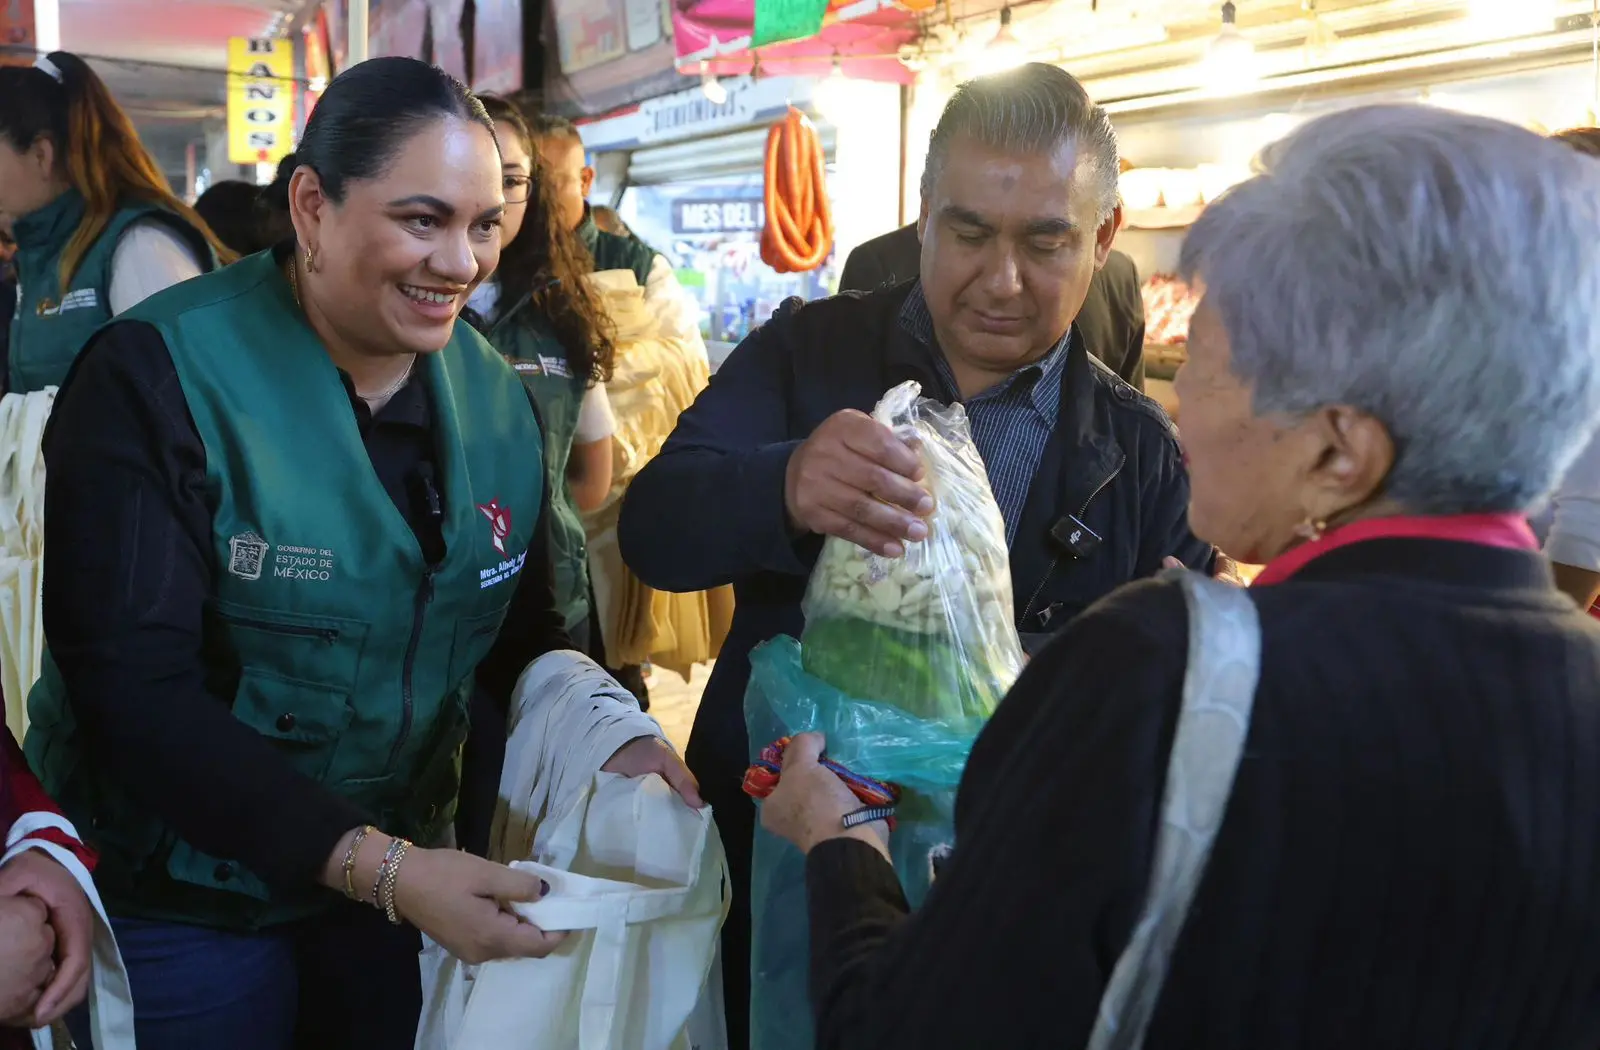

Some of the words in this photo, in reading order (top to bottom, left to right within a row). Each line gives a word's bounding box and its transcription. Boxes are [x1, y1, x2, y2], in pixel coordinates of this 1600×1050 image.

[681, 202, 721, 230] MES
[723, 201, 756, 229] DEL
[277, 544, 317, 555] GOBIERNO
[319, 548, 334, 557] DEL
[276, 554, 317, 567] ESTADO
[319, 559, 333, 569] DE
[480, 567, 498, 580] Mtra.
